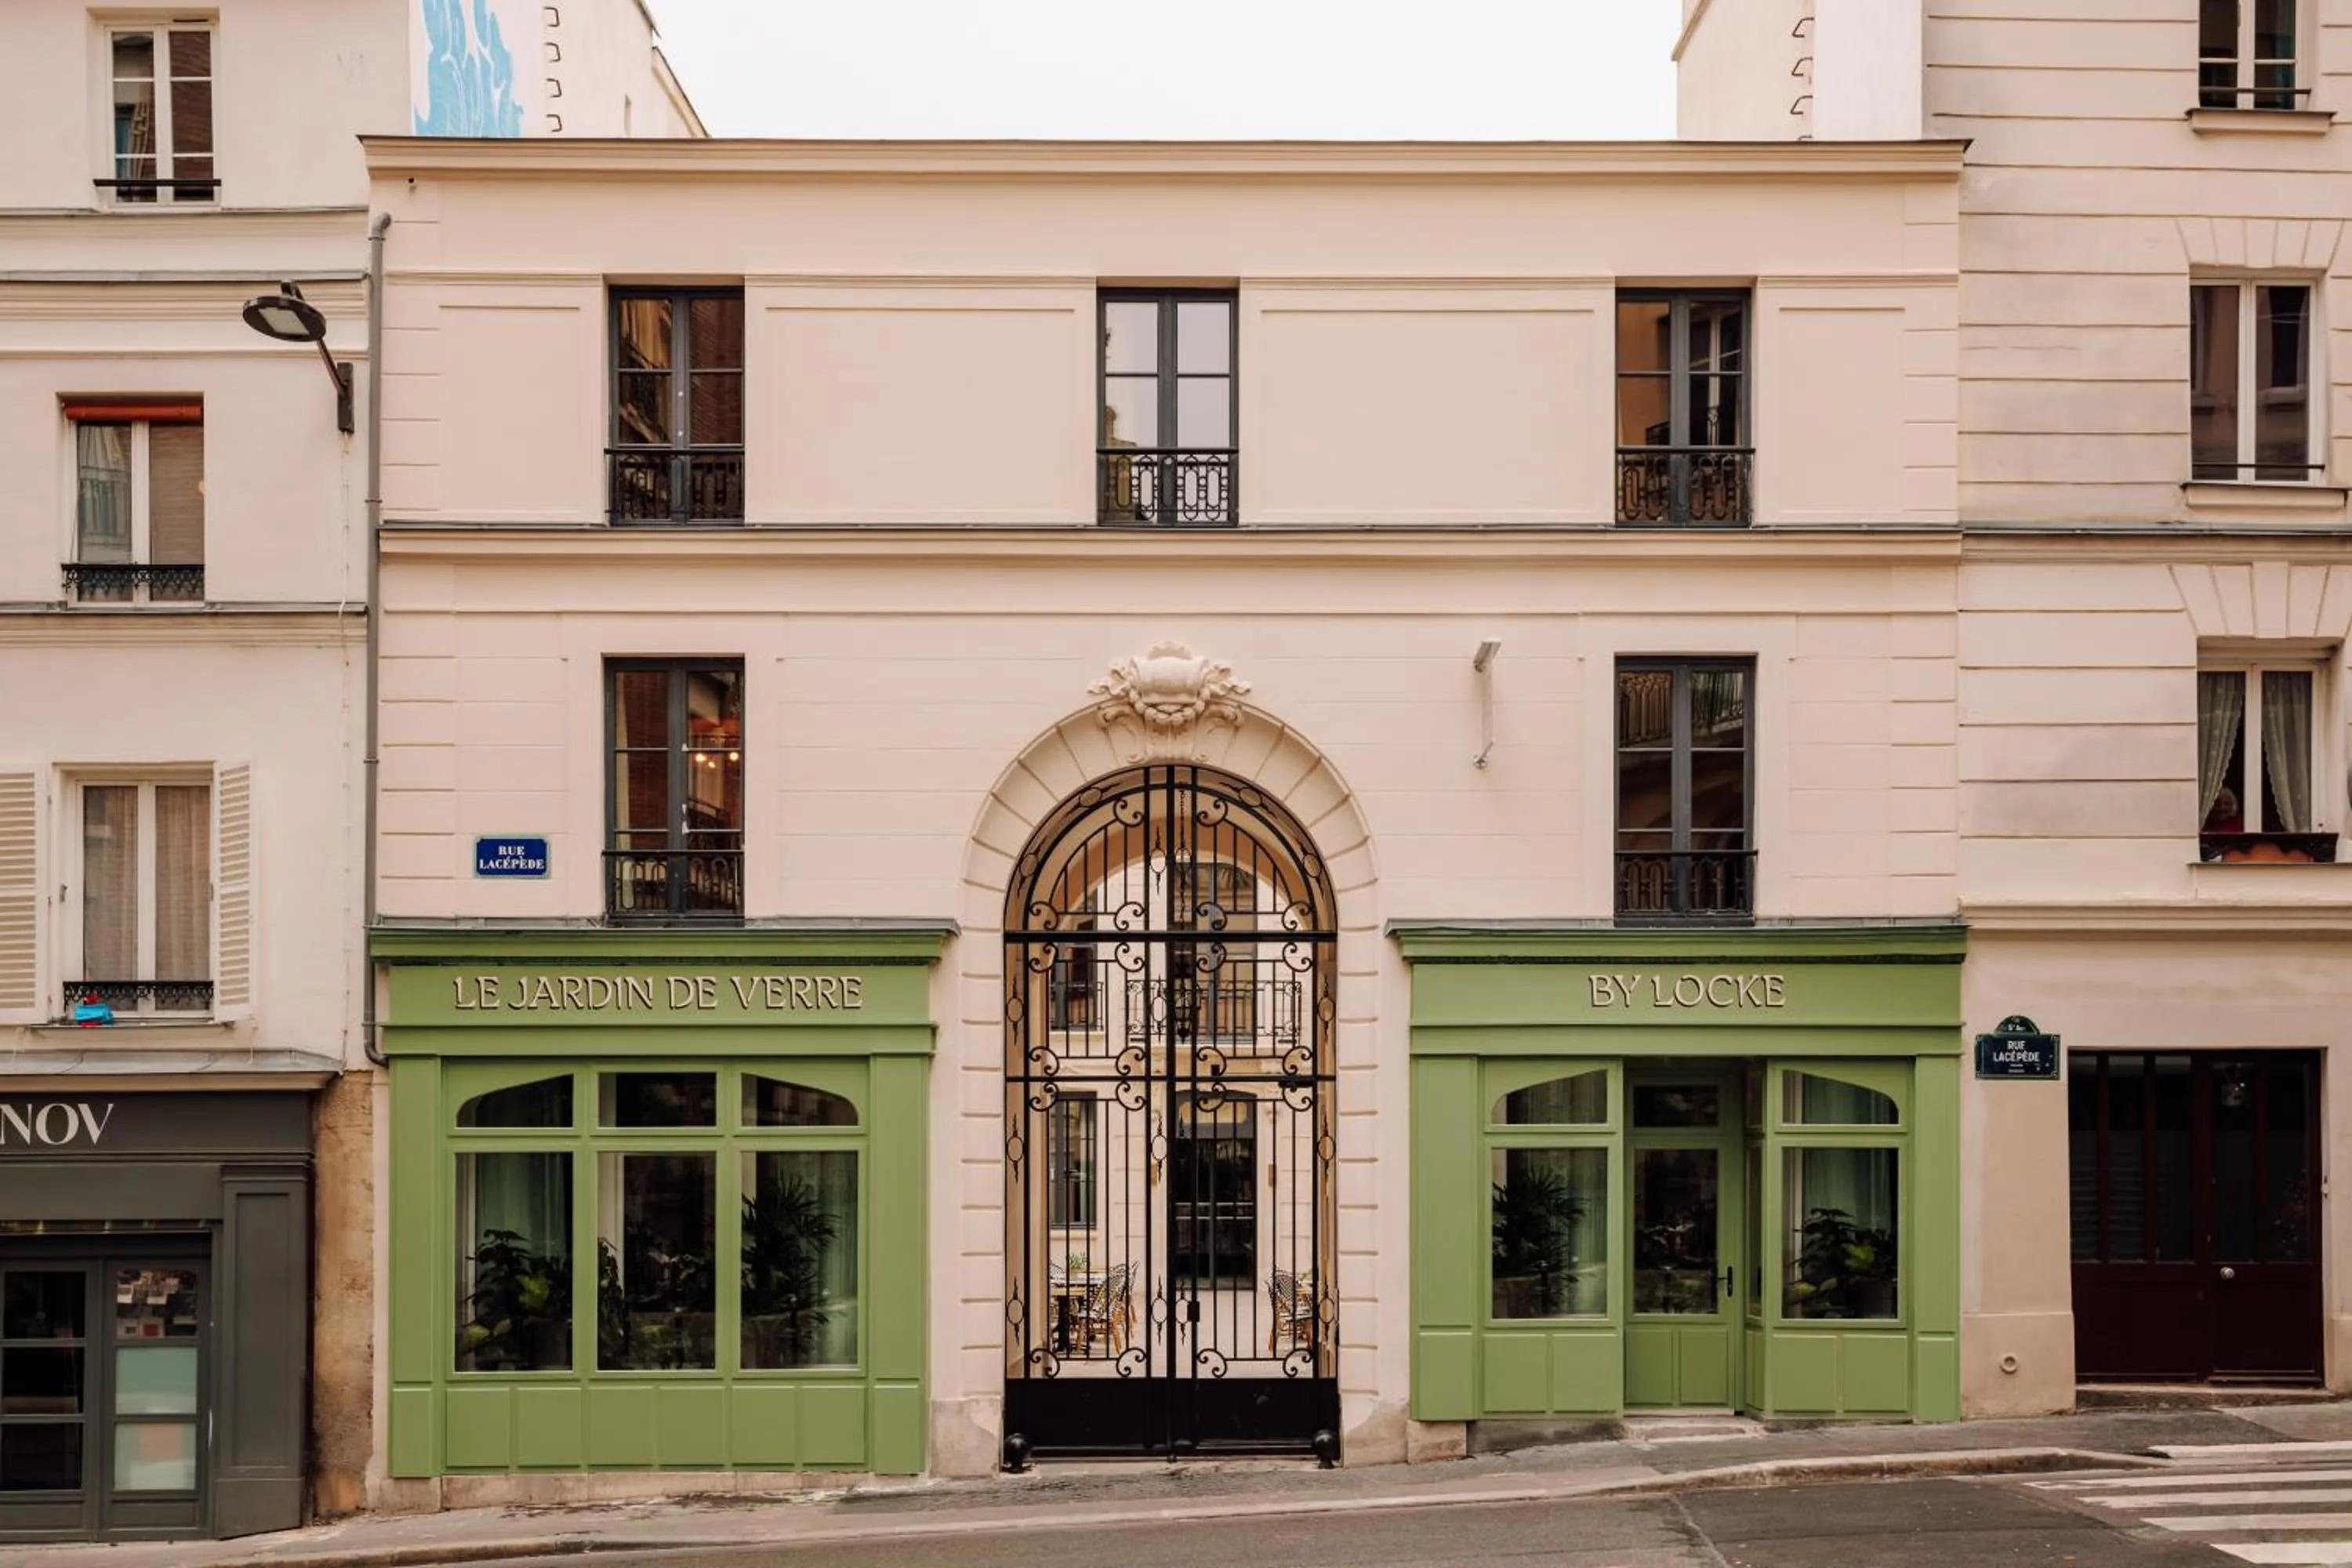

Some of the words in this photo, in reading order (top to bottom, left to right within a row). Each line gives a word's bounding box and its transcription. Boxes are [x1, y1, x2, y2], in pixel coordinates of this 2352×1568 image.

[498, 846, 524, 855] RUE
[479, 856, 544, 869] LACÉPÈDE
[453, 976, 499, 1010] LE
[509, 976, 653, 1010] JARDIN
[666, 976, 717, 1010] DE
[730, 976, 864, 1010] VERRE
[1588, 975, 1642, 1007] BY
[1651, 975, 1787, 1007] LOCKE
[2008, 1040, 2026, 1050] RUE
[0, 1103, 114, 1145] NOV
